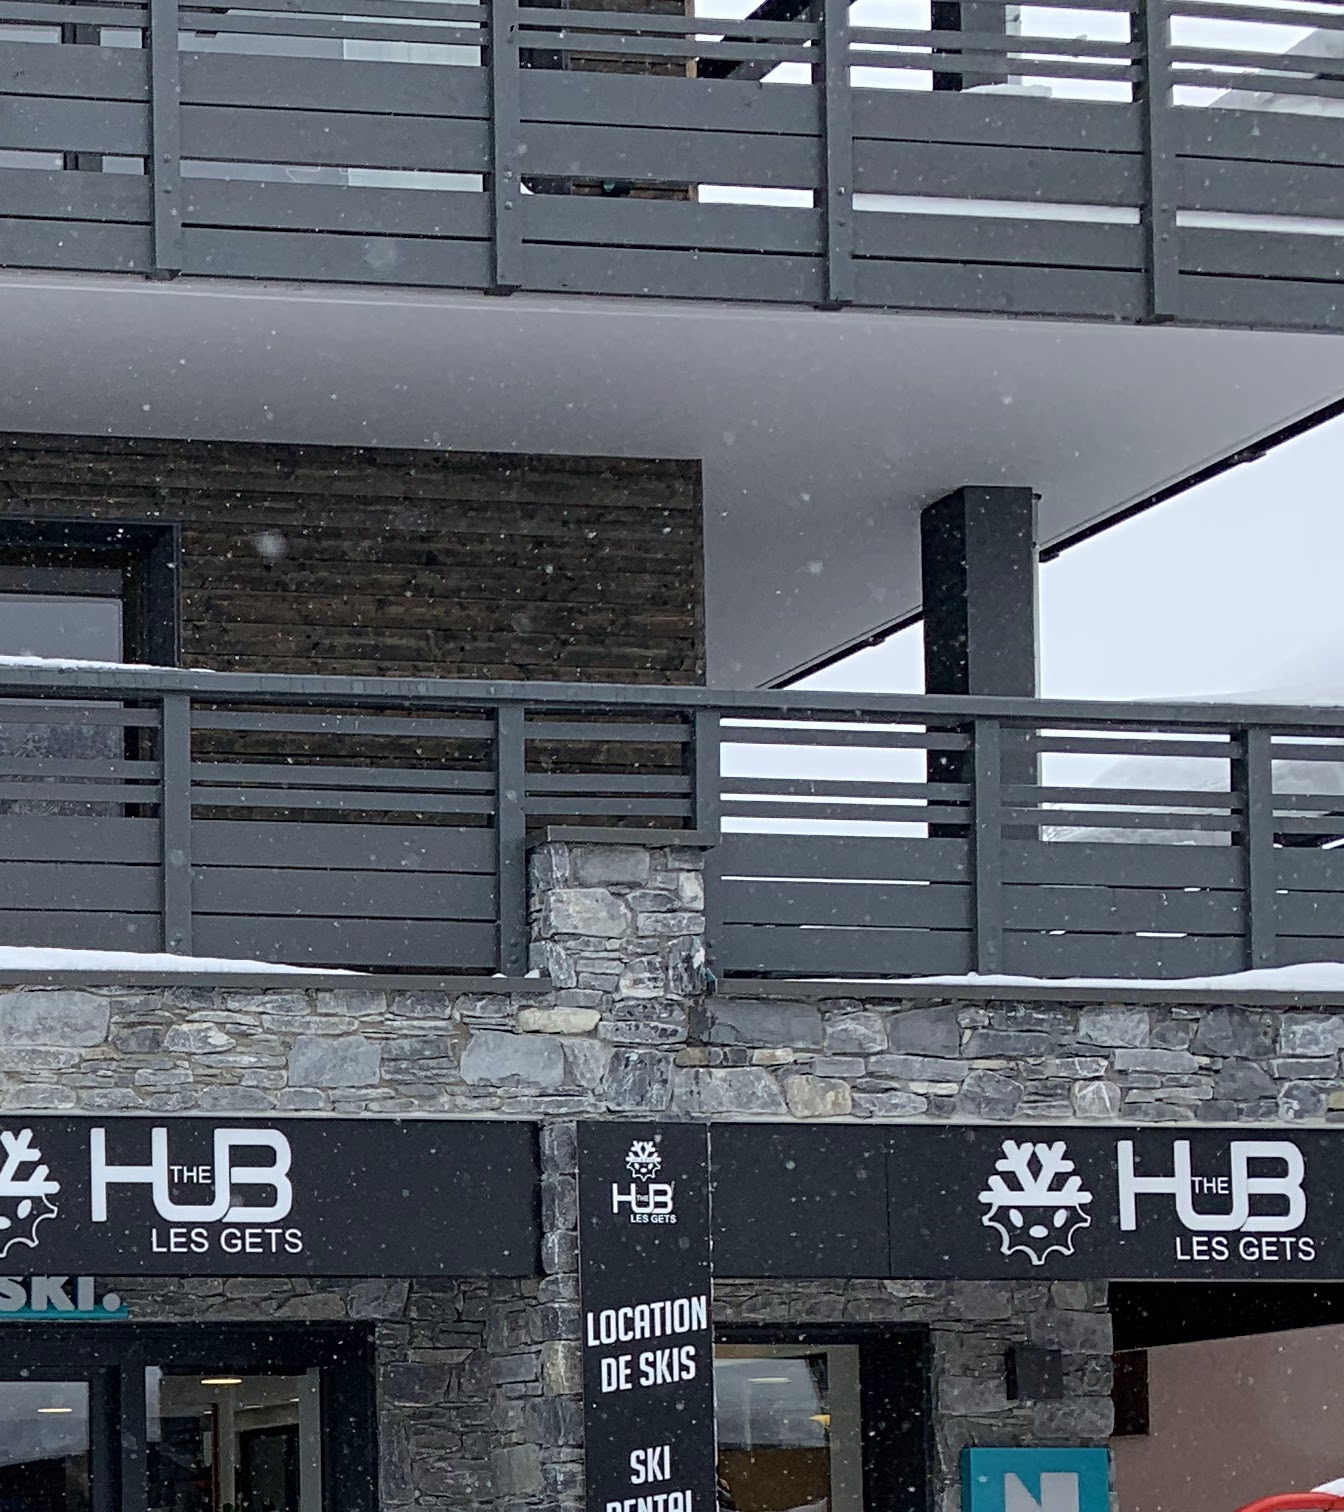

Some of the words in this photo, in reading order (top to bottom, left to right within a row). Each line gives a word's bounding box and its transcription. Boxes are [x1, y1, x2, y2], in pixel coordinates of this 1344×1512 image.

[91, 1127, 292, 1223] HUB
[170, 1164, 212, 1185] THE
[1117, 1140, 1307, 1233] HUB
[1190, 1175, 1230, 1195] THE
[612, 1183, 673, 1214] HUB
[630, 1214, 649, 1224] LES
[650, 1214, 678, 1224] GETS
[152, 1228, 210, 1254] LES
[219, 1228, 303, 1255] GETS
[1176, 1236, 1230, 1261] LES
[1239, 1236, 1316, 1262] GETS
[587, 1295, 708, 1347] LOCATION
[601, 1354, 632, 1393] DE
[639, 1345, 696, 1387] SKIS
[629, 1445, 671, 1485] SKI
